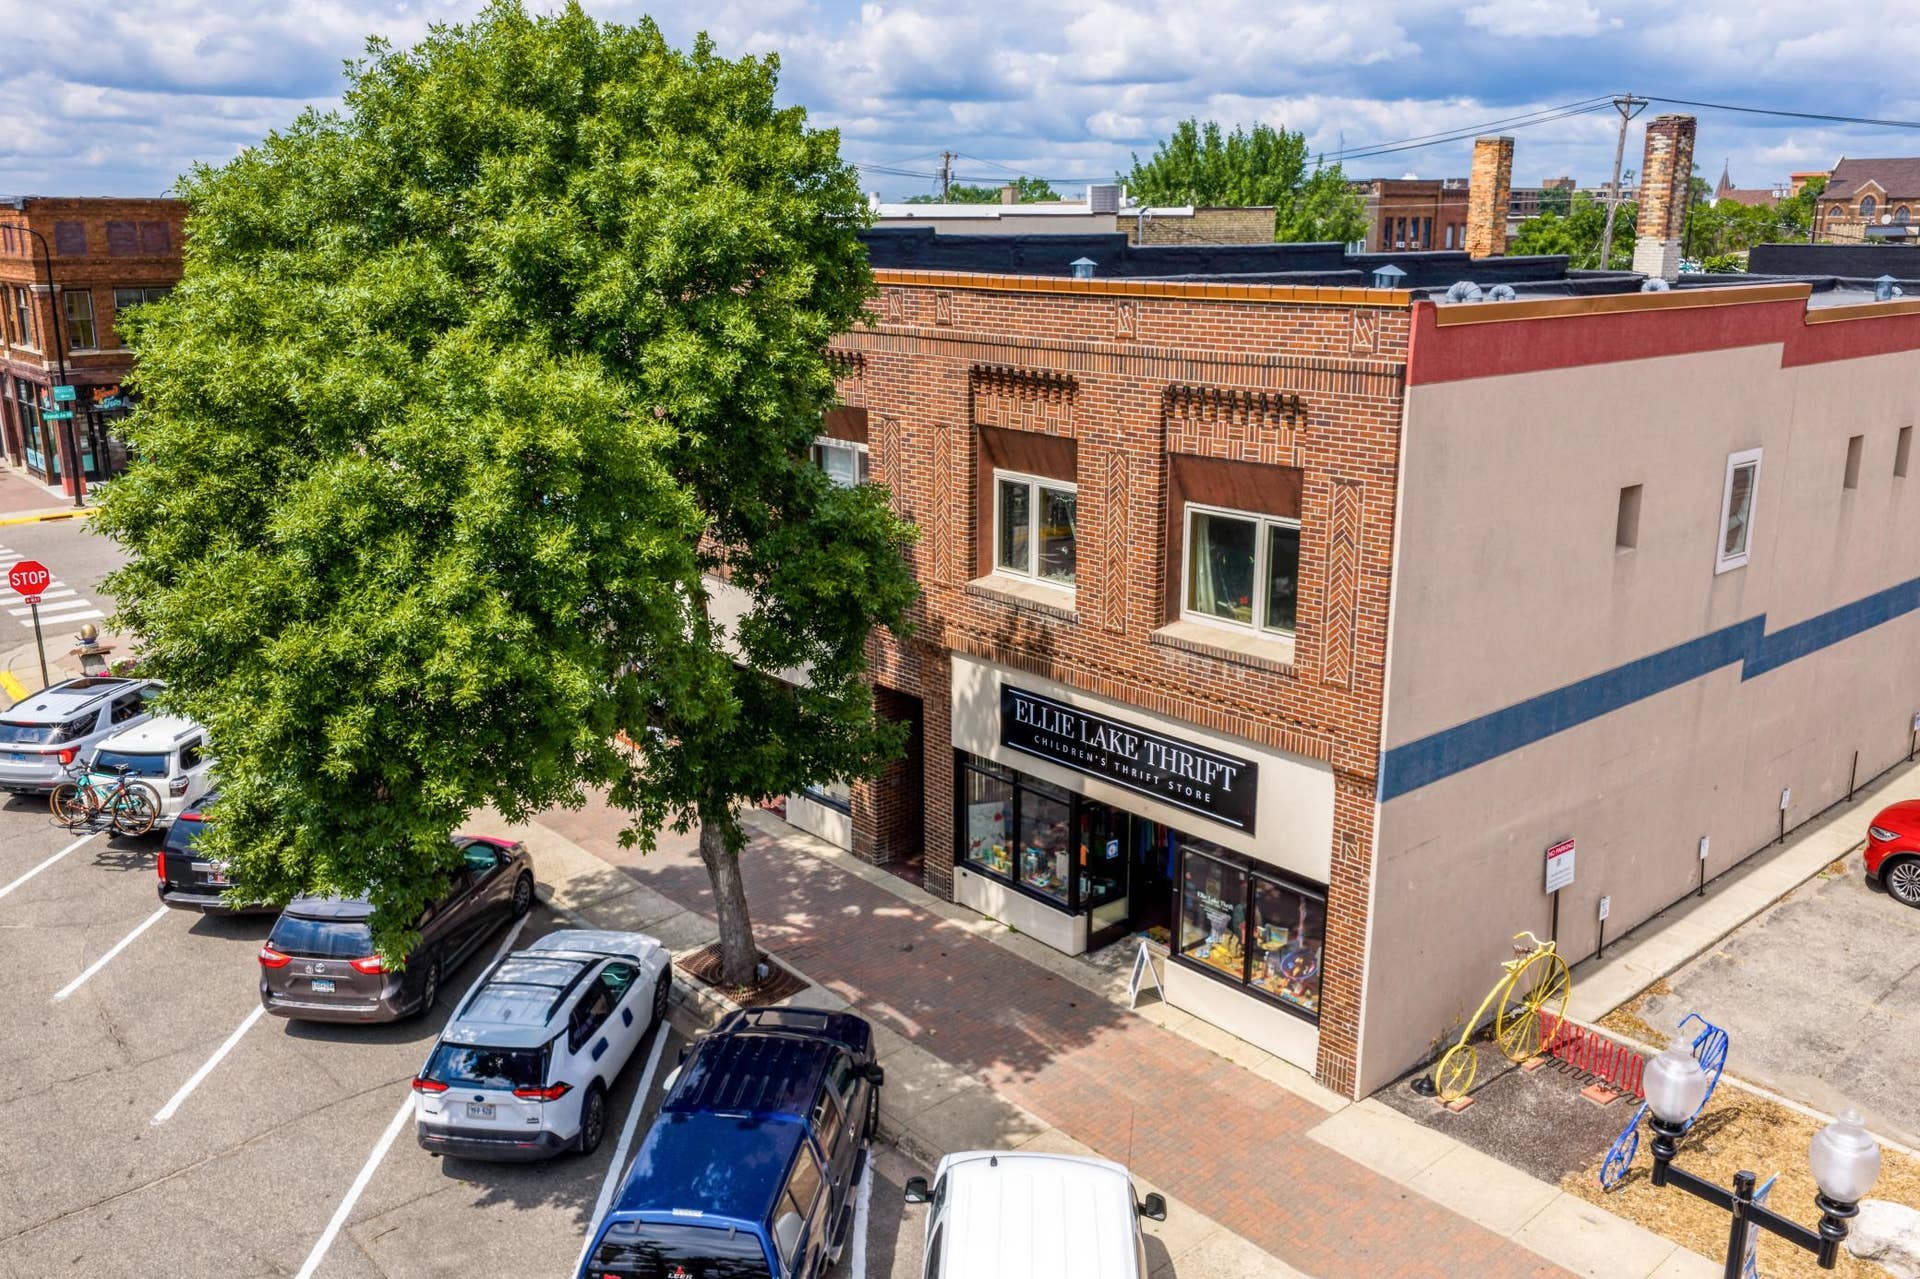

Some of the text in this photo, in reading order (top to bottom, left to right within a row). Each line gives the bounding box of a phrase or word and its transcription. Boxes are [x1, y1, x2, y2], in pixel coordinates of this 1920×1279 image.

[11, 570, 47, 586] STOP
[1015, 698, 1237, 792] ELLIE LAKE THRIFT
[1034, 735, 1211, 803] CHILDREN'S THRIFT STORE
